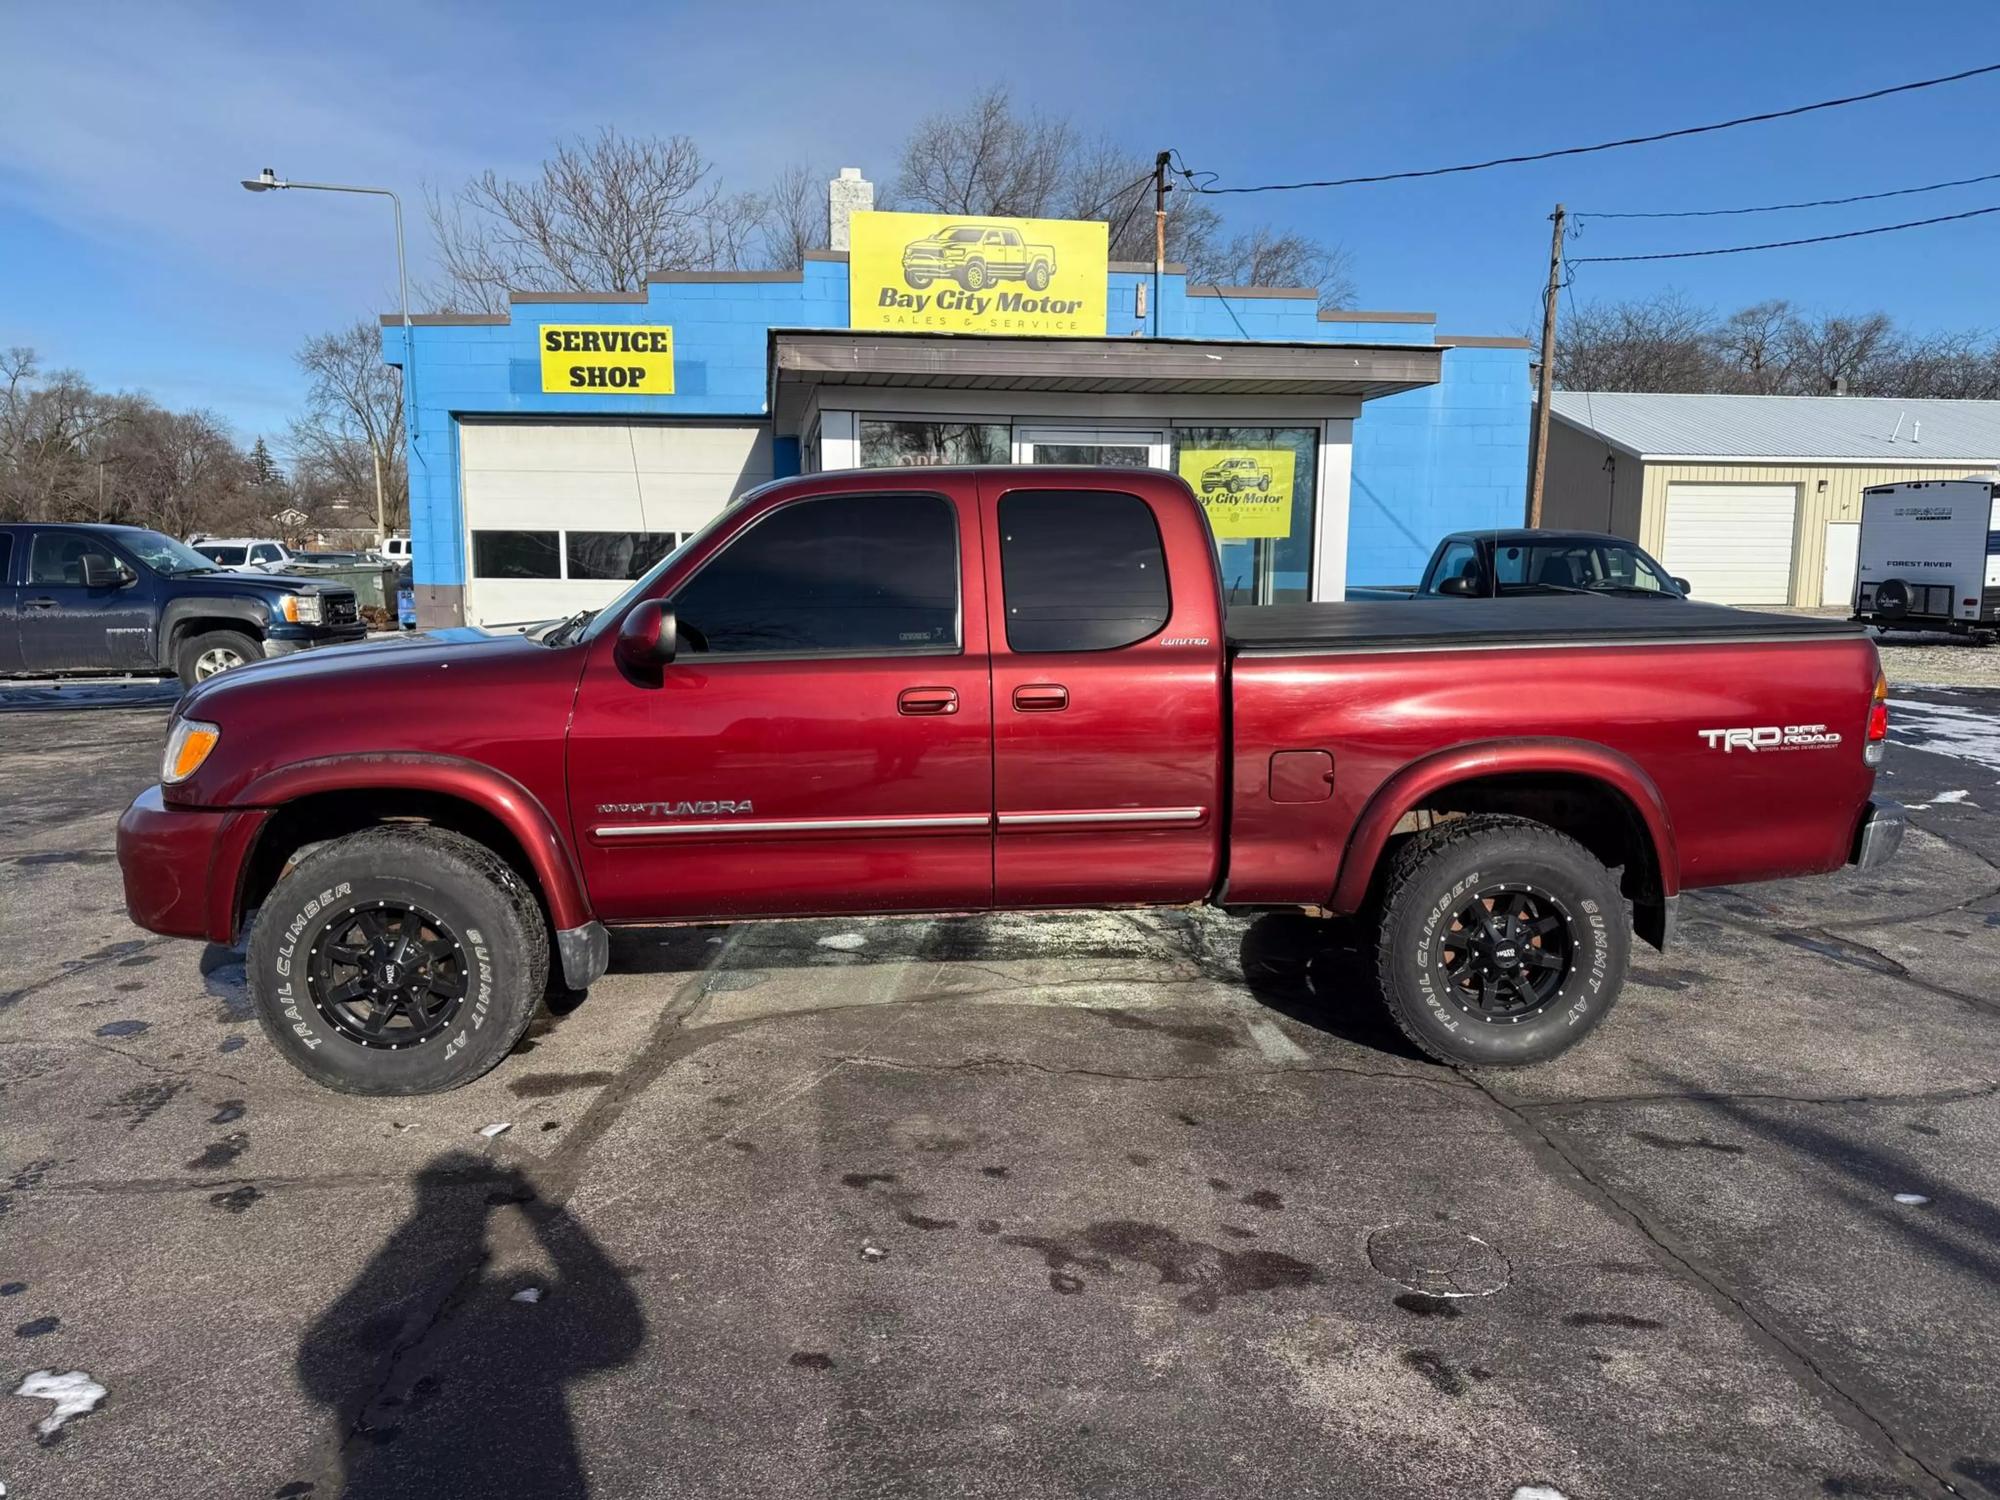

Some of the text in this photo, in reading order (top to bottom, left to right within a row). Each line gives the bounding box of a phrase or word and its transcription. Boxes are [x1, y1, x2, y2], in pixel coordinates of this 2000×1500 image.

[877, 287, 1083, 316] Bay City Motor
[883, 314, 1078, 330] SALES & SERVICE
[545, 331, 668, 353] SERVICE
[569, 366, 646, 388] SHOP
[1195, 493, 1284, 506] ay City Motor
[1698, 726, 1783, 753] TRD
[1783, 724, 1827, 734] OFF
[1783, 733, 1842, 745] ROAD
[646, 800, 754, 815] TUNDRA
[1417, 872, 1479, 1032] TRAIL CLIMBER
[1567, 899, 1608, 1026] SUMMIT AT
[276, 882, 352, 1050] TRAIL CLIMBER
[444, 928, 492, 1060] SUMMIT AT
